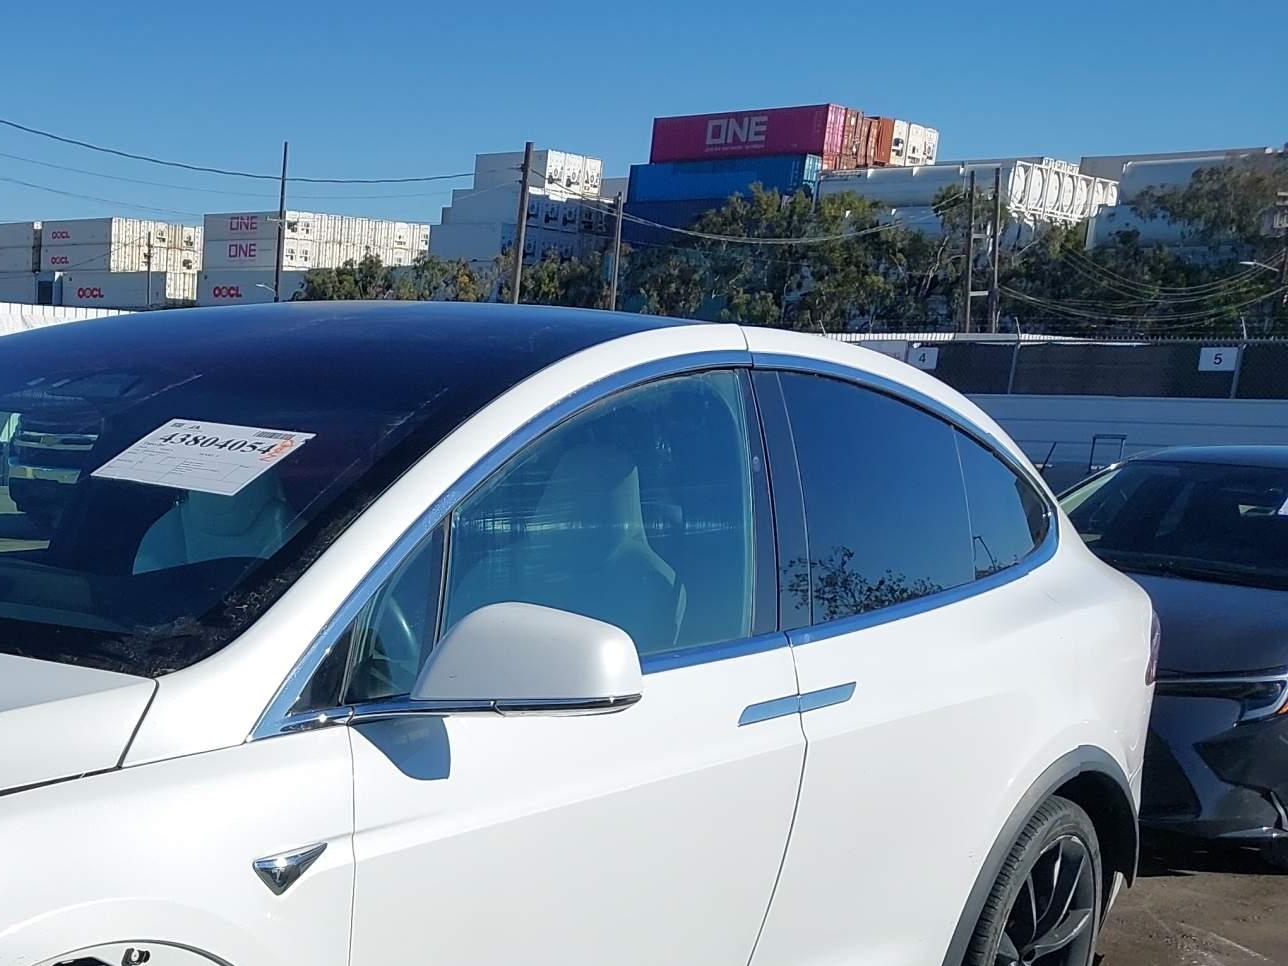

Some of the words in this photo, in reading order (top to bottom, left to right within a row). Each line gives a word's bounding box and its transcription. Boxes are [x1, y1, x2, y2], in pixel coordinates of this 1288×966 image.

[706, 116, 768, 144] ONE
[229, 215, 258, 231] ONE
[52, 231, 70, 239] OOCL
[228, 243, 257, 258] ONE
[77, 287, 104, 298] OOCL
[213, 286, 242, 298] OOCL
[918, 352, 927, 364] 4
[1213, 353, 1223, 365] 5
[159, 431, 278, 455] 43804054
